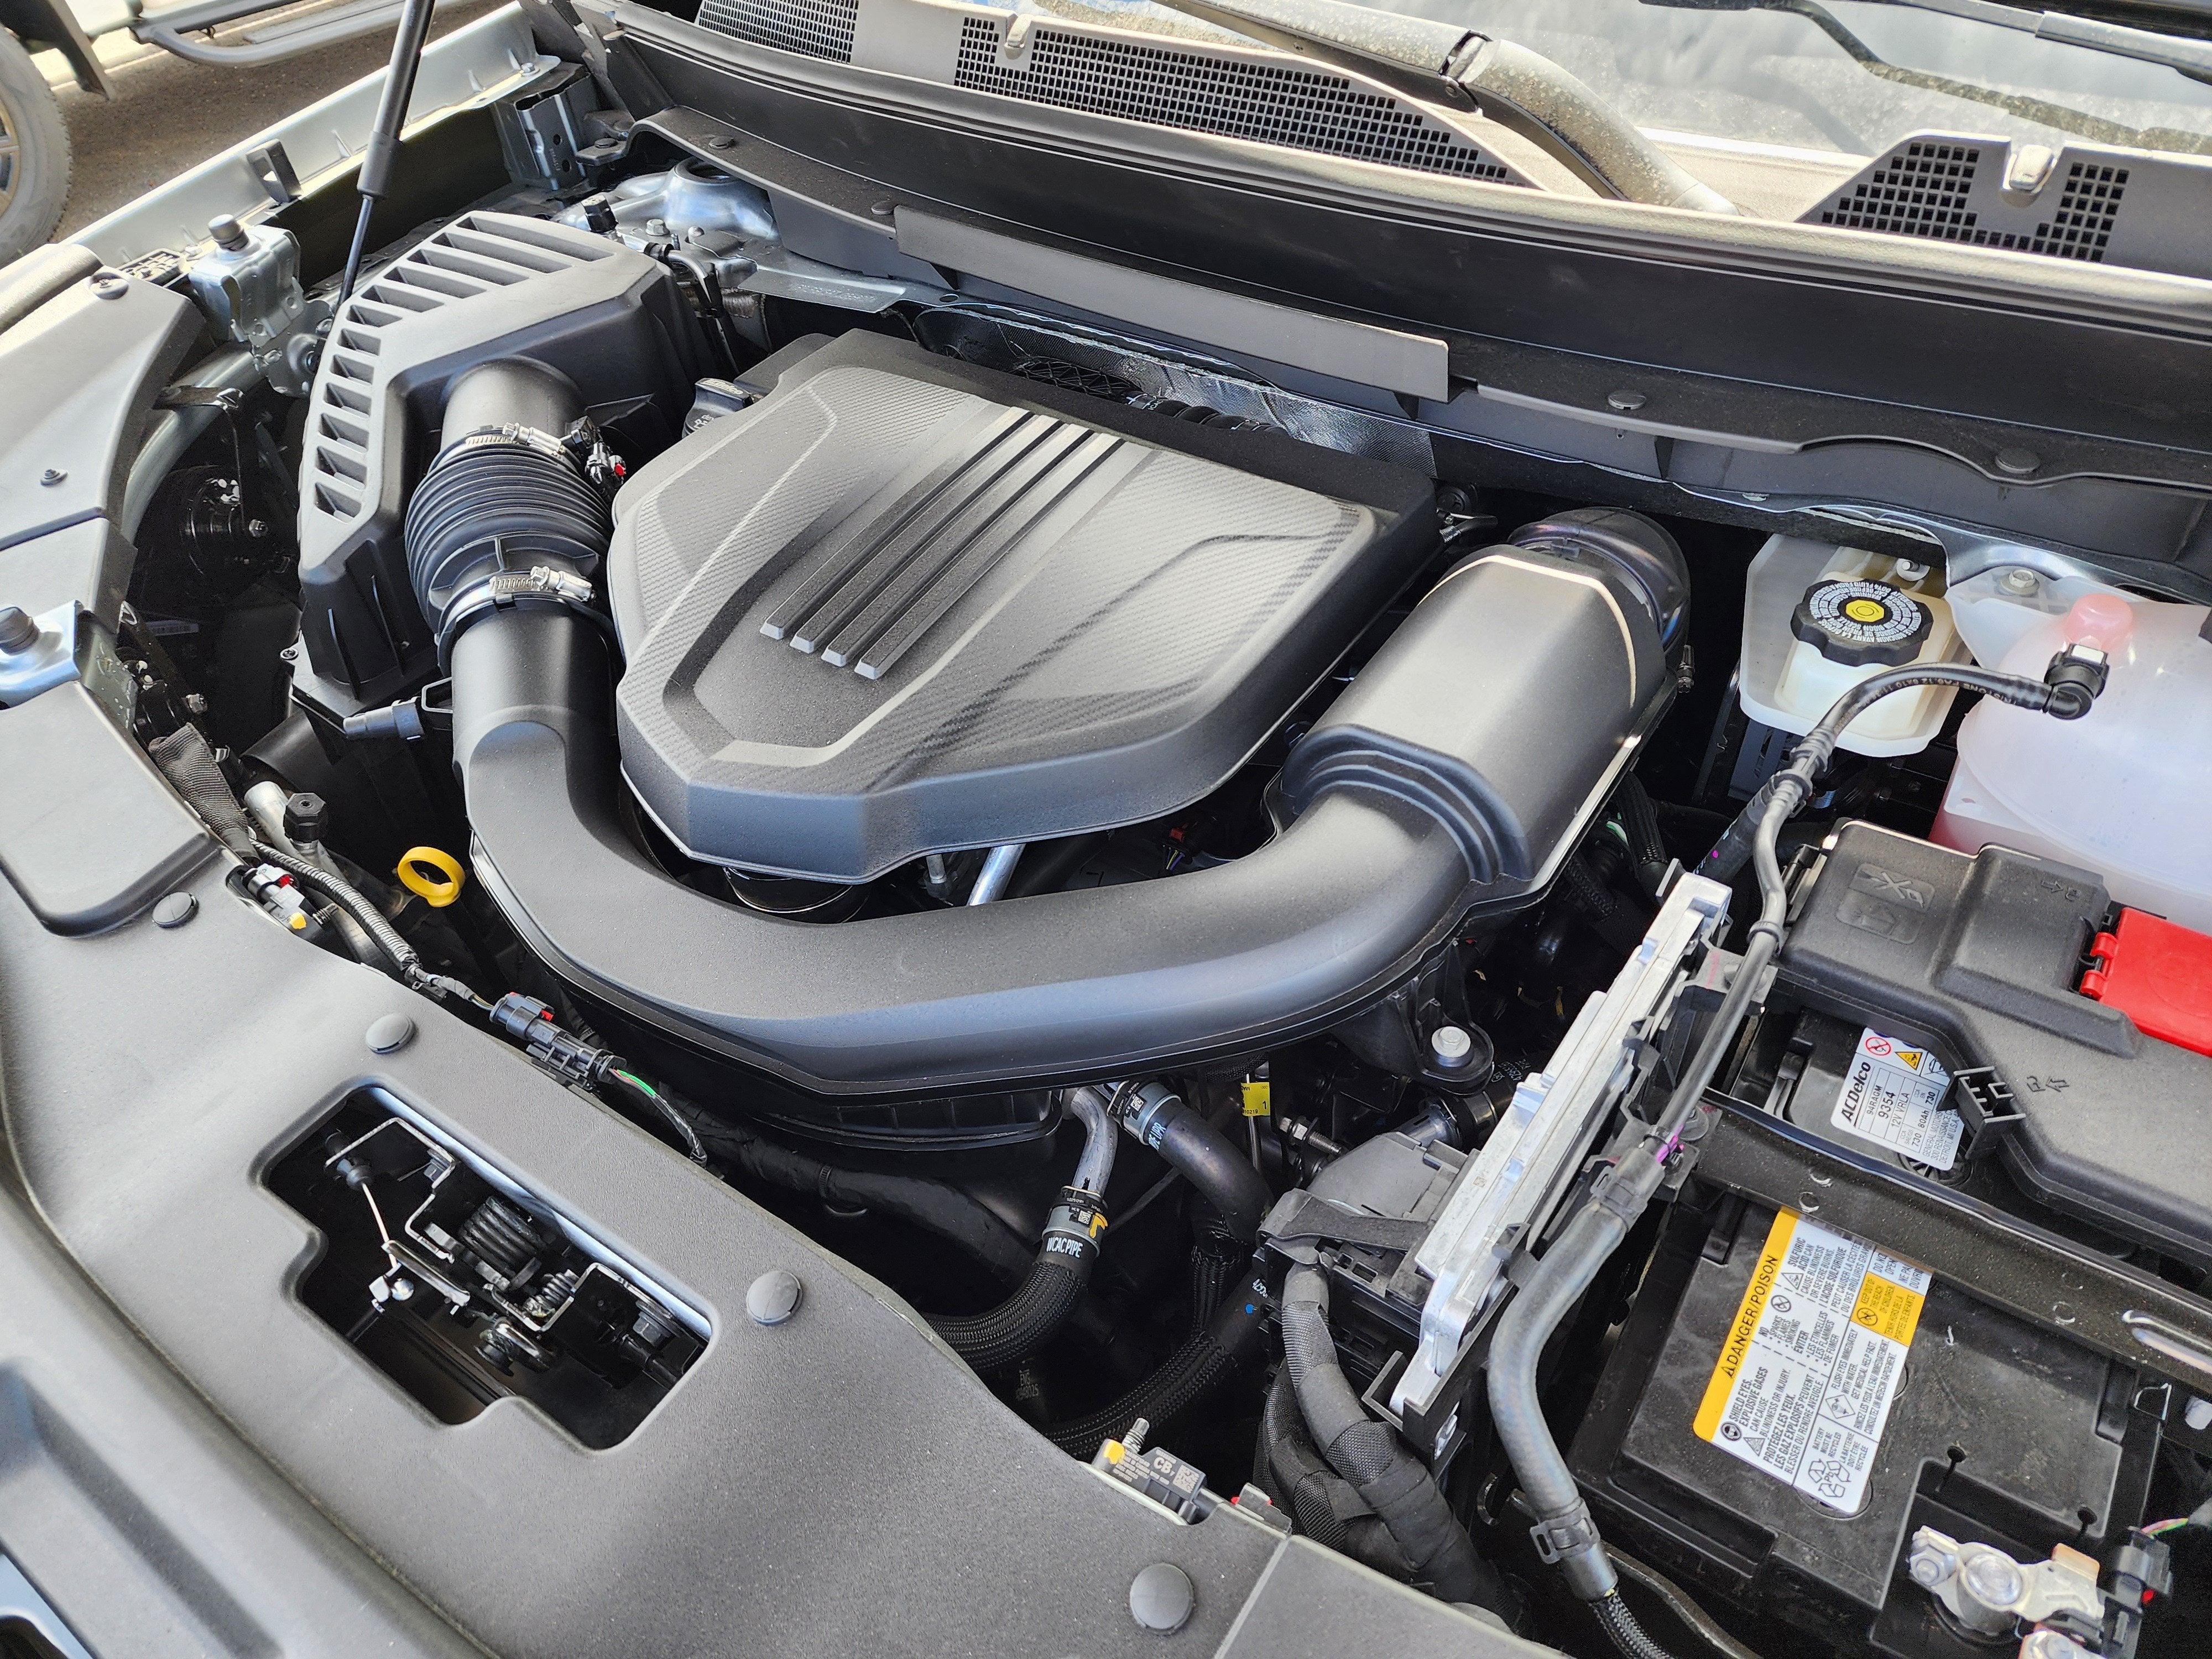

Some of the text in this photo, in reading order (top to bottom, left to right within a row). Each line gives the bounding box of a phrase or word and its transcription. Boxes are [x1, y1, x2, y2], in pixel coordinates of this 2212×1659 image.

[1838, 1060, 1872, 1123] ACDelco
[1865, 1084, 1883, 1116] 94RAGM
[1924, 1090, 1936, 1106] 730
[1262, 1100, 1267, 1110] 1
[1877, 1089, 1896, 1120] 9354
[1890, 1090, 1911, 1129] 12V VRLA
[1917, 1108, 1929, 1129] 80Ah
[1150, 1122, 1167, 1140] UPR
[1911, 1131, 1922, 1147] 730
[1922, 1109, 1943, 1157] GENERAL MOTORS
[1934, 1114, 1952, 1151] RENAISSANCE
[1930, 1149, 1940, 1161] 300
[1065, 1239, 1084, 1258] PIPE
[1786, 1235, 1806, 1267] SULFURIC
[1797, 1243, 1814, 1271] ACID CAN
[1799, 1244, 1825, 1295] CAUSE BLINDNESS
[1809, 1246, 1835, 1299] OR SEVERE BURNS.
[1844, 1261, 1854, 1272] LA
[1872, 1251, 1888, 1273] DO NO
[1819, 1245, 1848, 1304] L'ACIDE SULFURIQUE
[1836, 1270, 1851, 1294] CAUSER
[1898, 1272, 1909, 1284] NE
[1726, 1253, 1779, 1366] DANGER/POISON
[1830, 1291, 1843, 1309] PEUT
[1840, 1302, 1851, 1313] OU
[1843, 1291, 1855, 1305] DES
[1757, 1325, 1770, 1338] NO
[1768, 1314, 1783, 1338] SPARKS
[1776, 1318, 1791, 1342] FLAMES
[1784, 1318, 1801, 1345] SMOKING
[1805, 1342, 1817, 1355] LES
[1814, 1318, 1835, 1360] LES FLAMMES
[1823, 1333, 1840, 1364] DE FUMER
[1830, 1327, 1859, 1390] FLUSH EYES IMMEDIATELY
[1861, 1353, 1872, 1368] HELP
[1840, 1379, 1853, 1395] WITH
[1854, 1365, 1869, 1390] MEDICAL
[1728, 1375, 1754, 1423] SHIELD EYES.
[1738, 1365, 1768, 1428] EXPLOSIVE GASES
[1759, 1366, 1791, 1438] BLINDNESS OR INJURY.
[1780, 1390, 1797, 1415] YEUX.
[1850, 1387, 1861, 1400] GET
[1861, 1389, 1873, 1405] YEUX
[1749, 1395, 1769, 1433] CAN CAUSE
[1859, 1401, 1869, 1413] LES
[1772, 1373, 1815, 1470] LES GAZ EXPLOSIFS PEUVENT
[1775, 1411, 1789, 1428] LES
[1783, 1377, 1825, 1475] BLESSER OU RENDRE AVEUGLE.
[1812, 1426, 1825, 1451] BATTERY
[1819, 1431, 1833, 1454] MUST BE
[1828, 1431, 1842, 1458] RECYCLED
[1838, 1431, 1855, 1464] LA BATTERIE
[1846, 1453, 1856, 1468] DOIT
[1823, 1469, 1834, 1483] Pb
